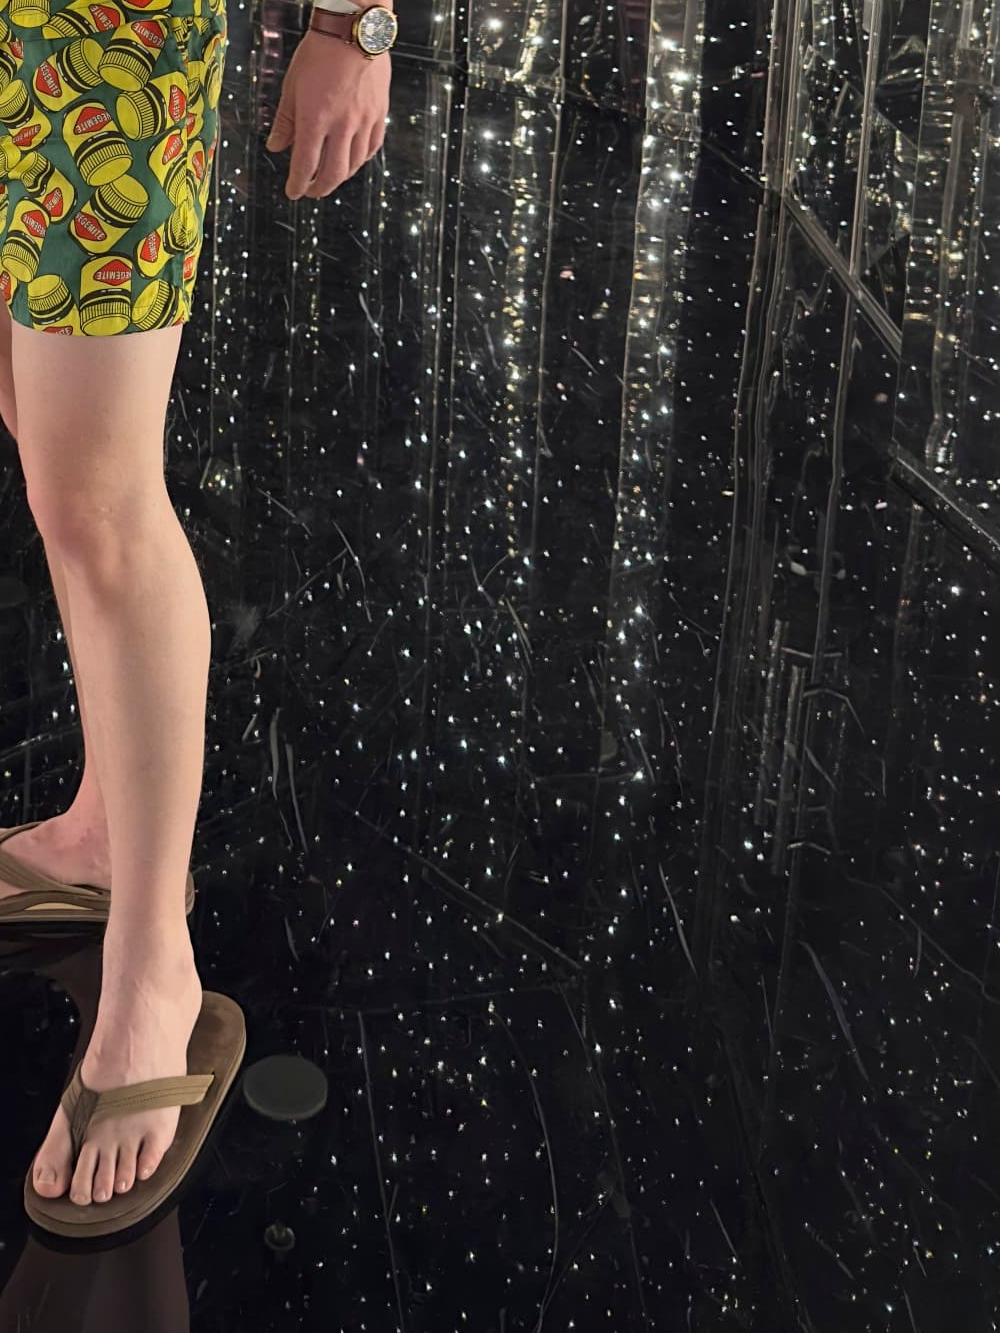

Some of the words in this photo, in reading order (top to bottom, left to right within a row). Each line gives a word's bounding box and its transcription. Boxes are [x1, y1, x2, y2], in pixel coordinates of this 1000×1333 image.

[132, 22, 165, 47] VEGEMITE
[39, 61, 61, 96] VEGEMITE
[74, 110, 111, 133] VEGEMITE
[74, 213, 105, 241] VEGEMITE
